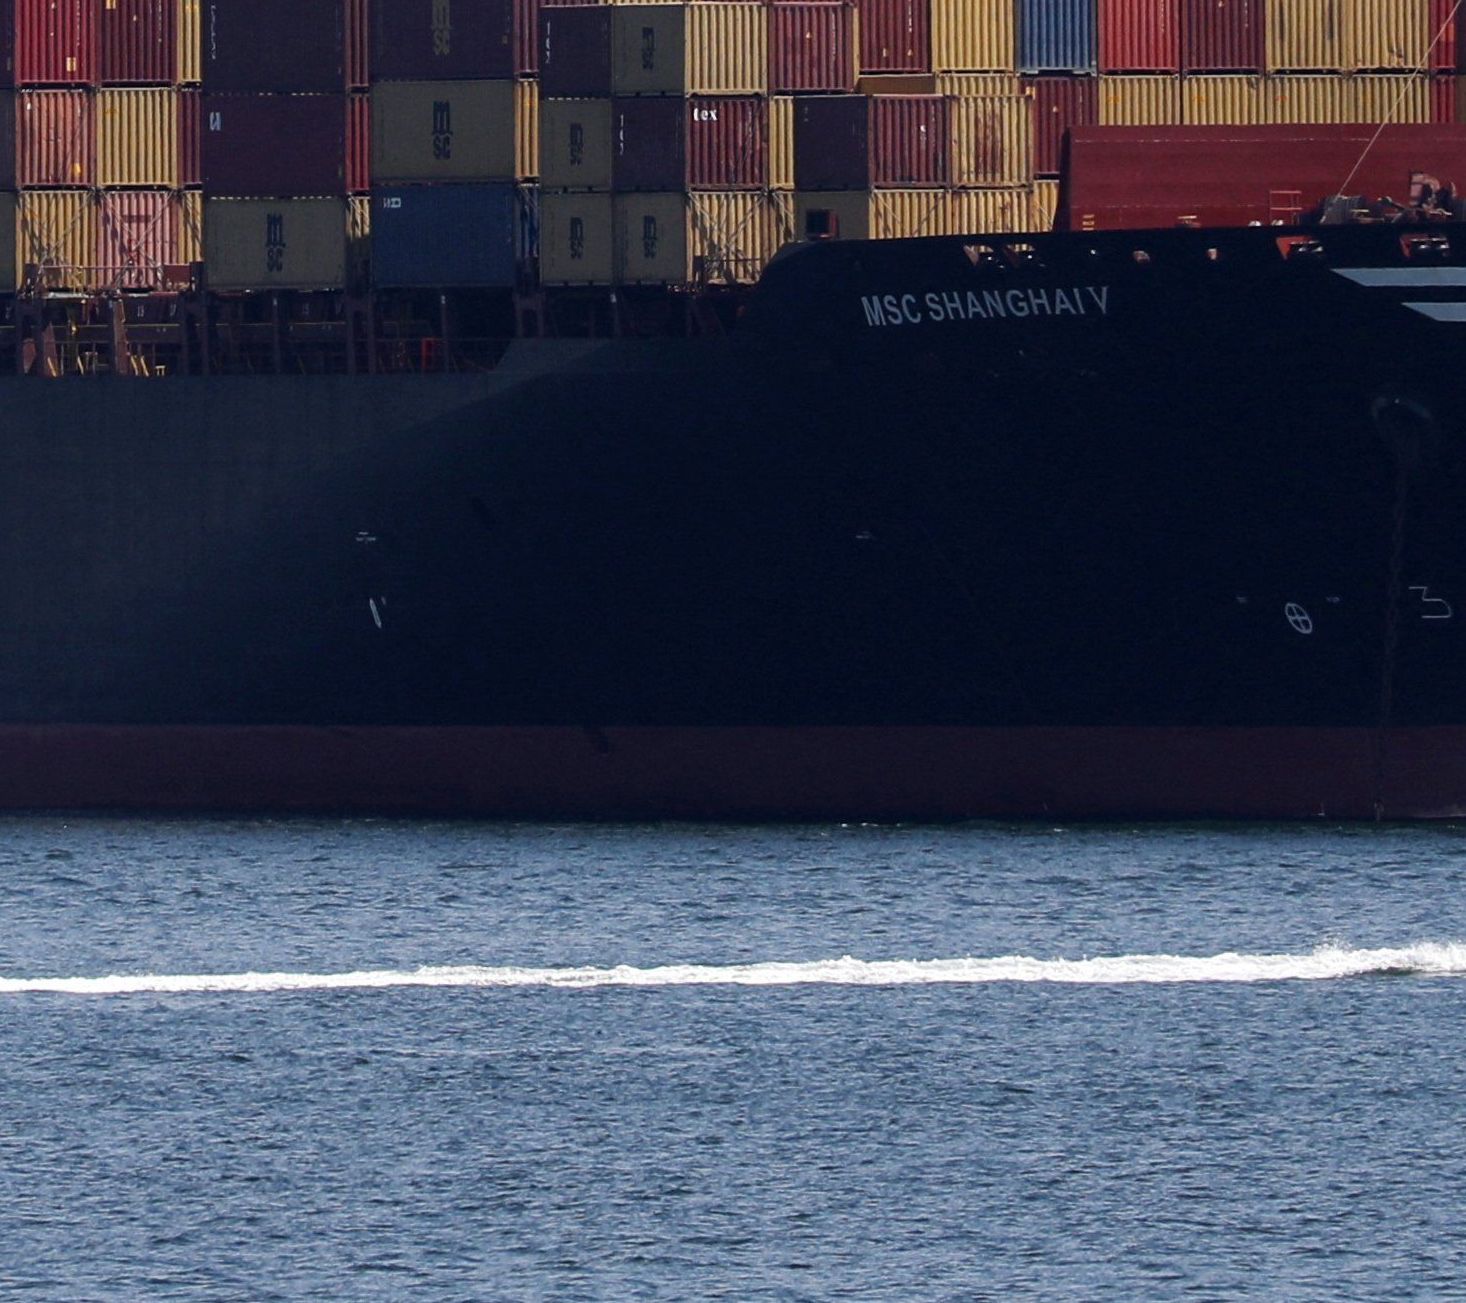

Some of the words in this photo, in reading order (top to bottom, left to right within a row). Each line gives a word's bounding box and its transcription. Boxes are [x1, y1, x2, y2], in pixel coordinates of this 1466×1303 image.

[861, 293, 921, 326] MSC
[924, 288, 1086, 322] SHANGHAI
[1086, 285, 1110, 314] V
